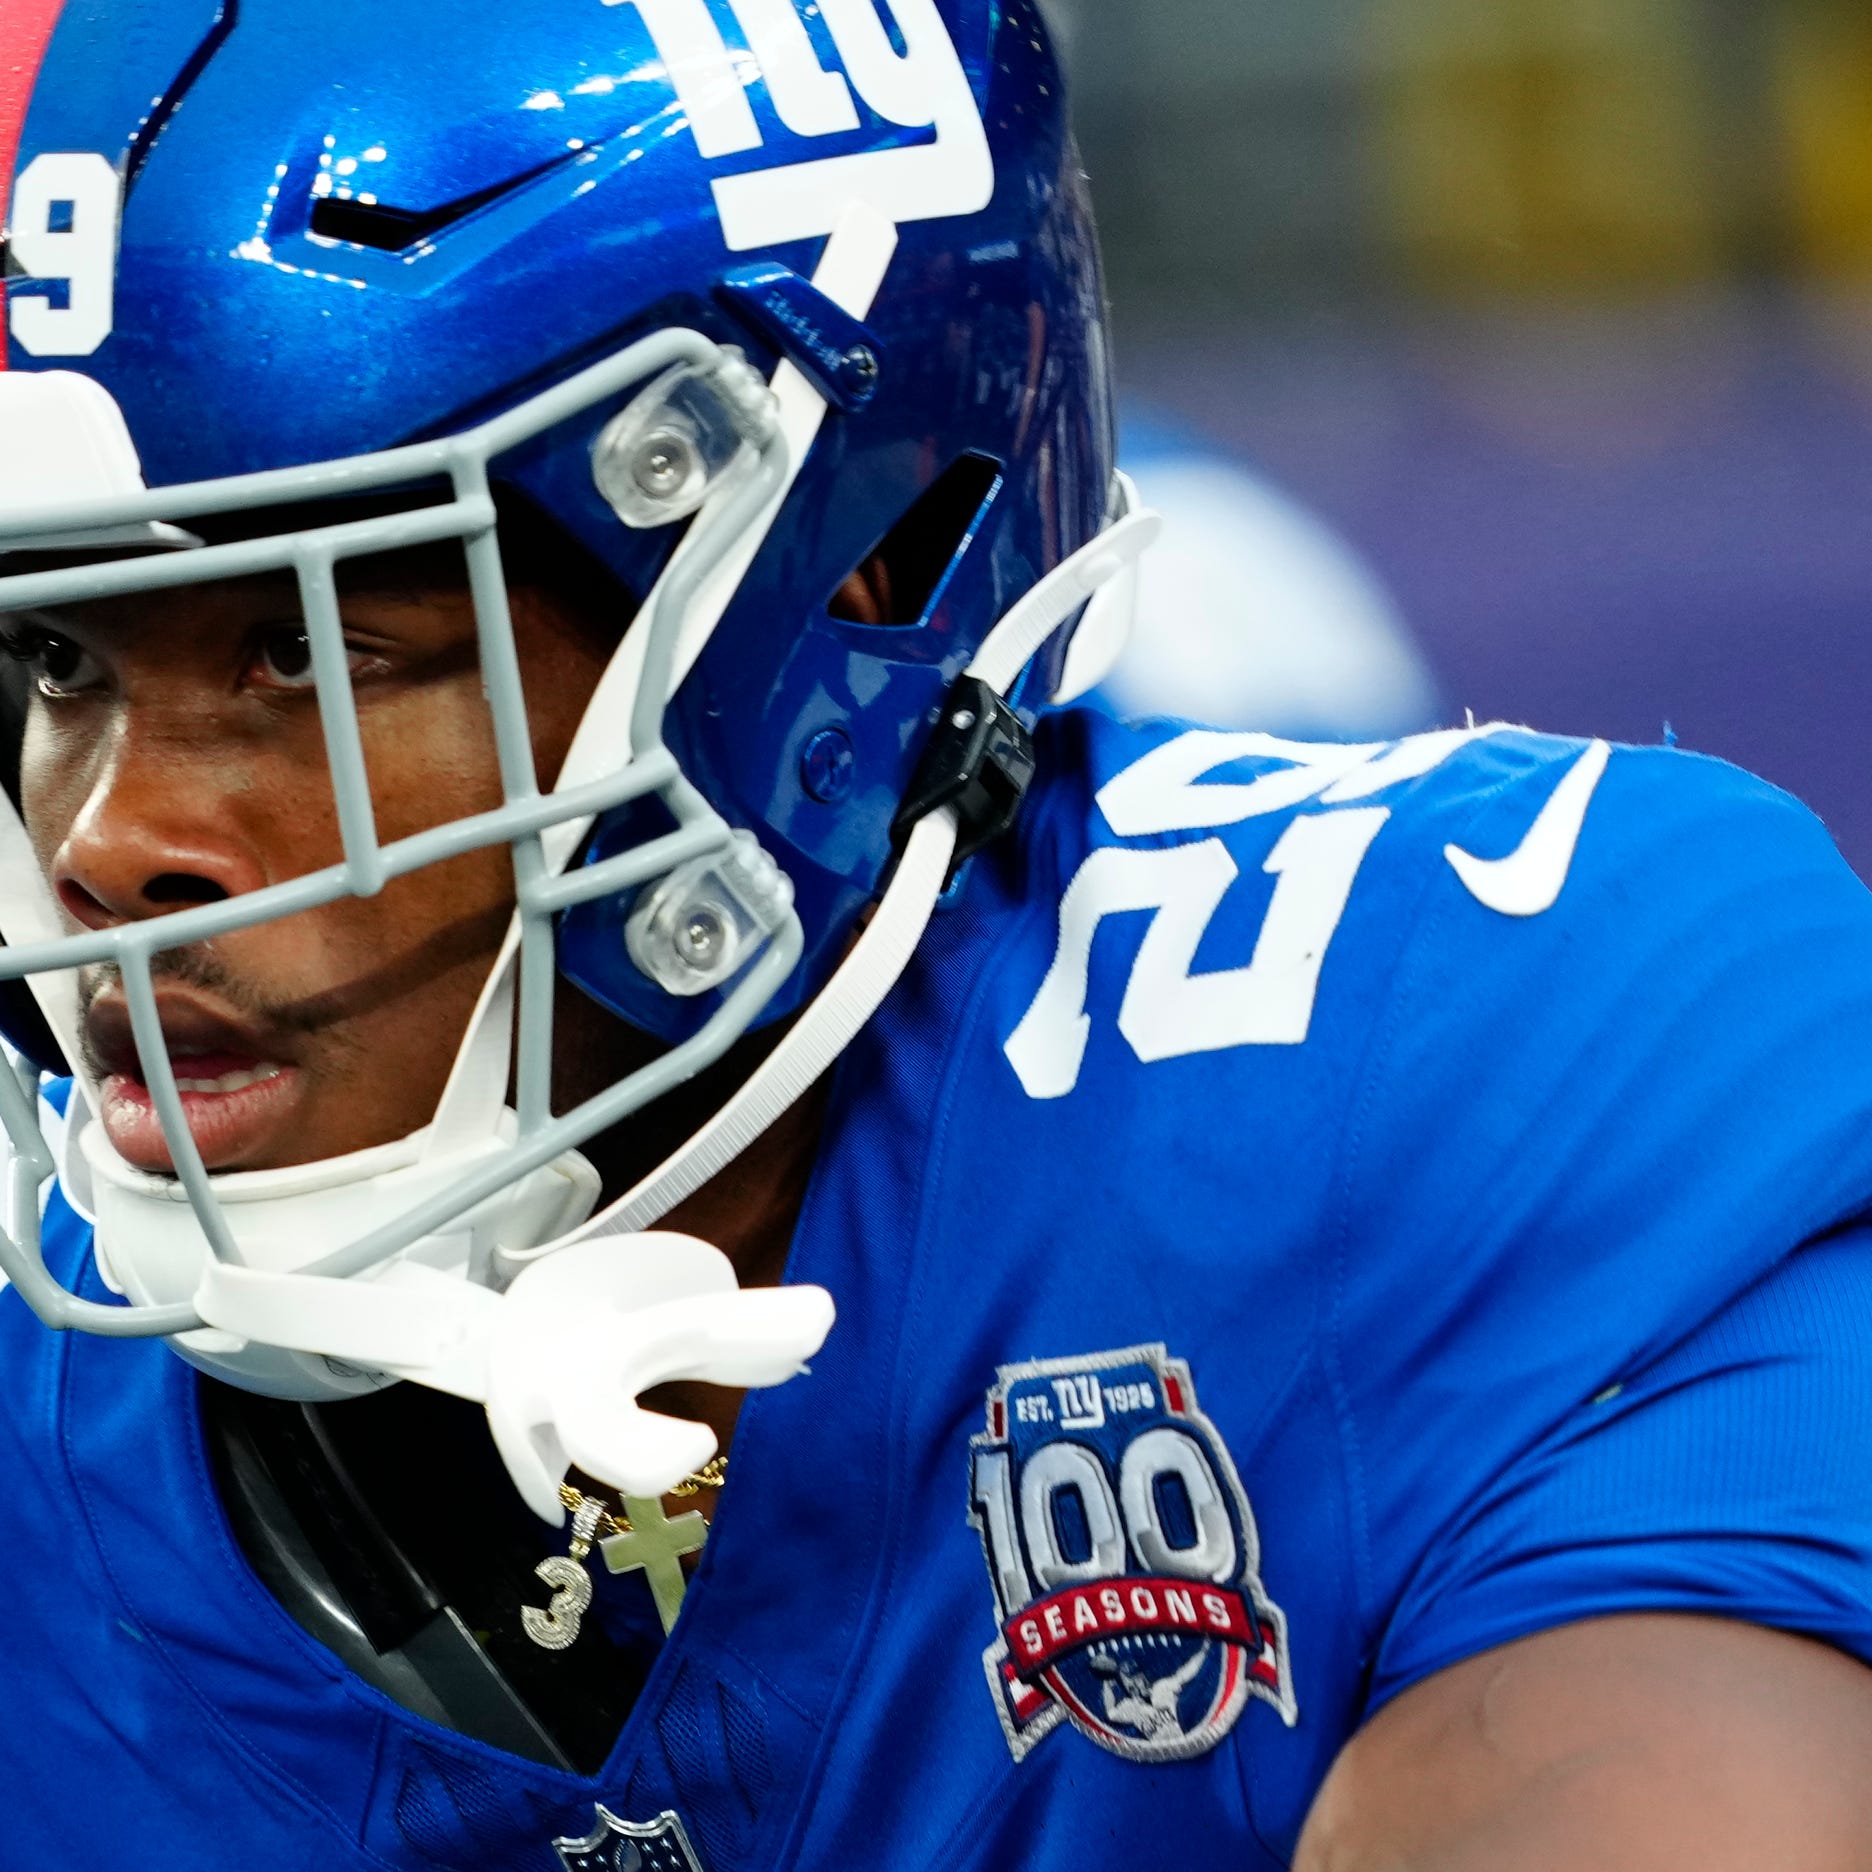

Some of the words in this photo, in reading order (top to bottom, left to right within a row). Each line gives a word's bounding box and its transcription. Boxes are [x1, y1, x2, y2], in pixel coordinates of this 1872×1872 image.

[1003, 721, 1536, 1099] 29
[1015, 1393, 1054, 1423] EST.
[974, 1427, 1236, 1617] 100
[1019, 1587, 1232, 1654] SEASONS
